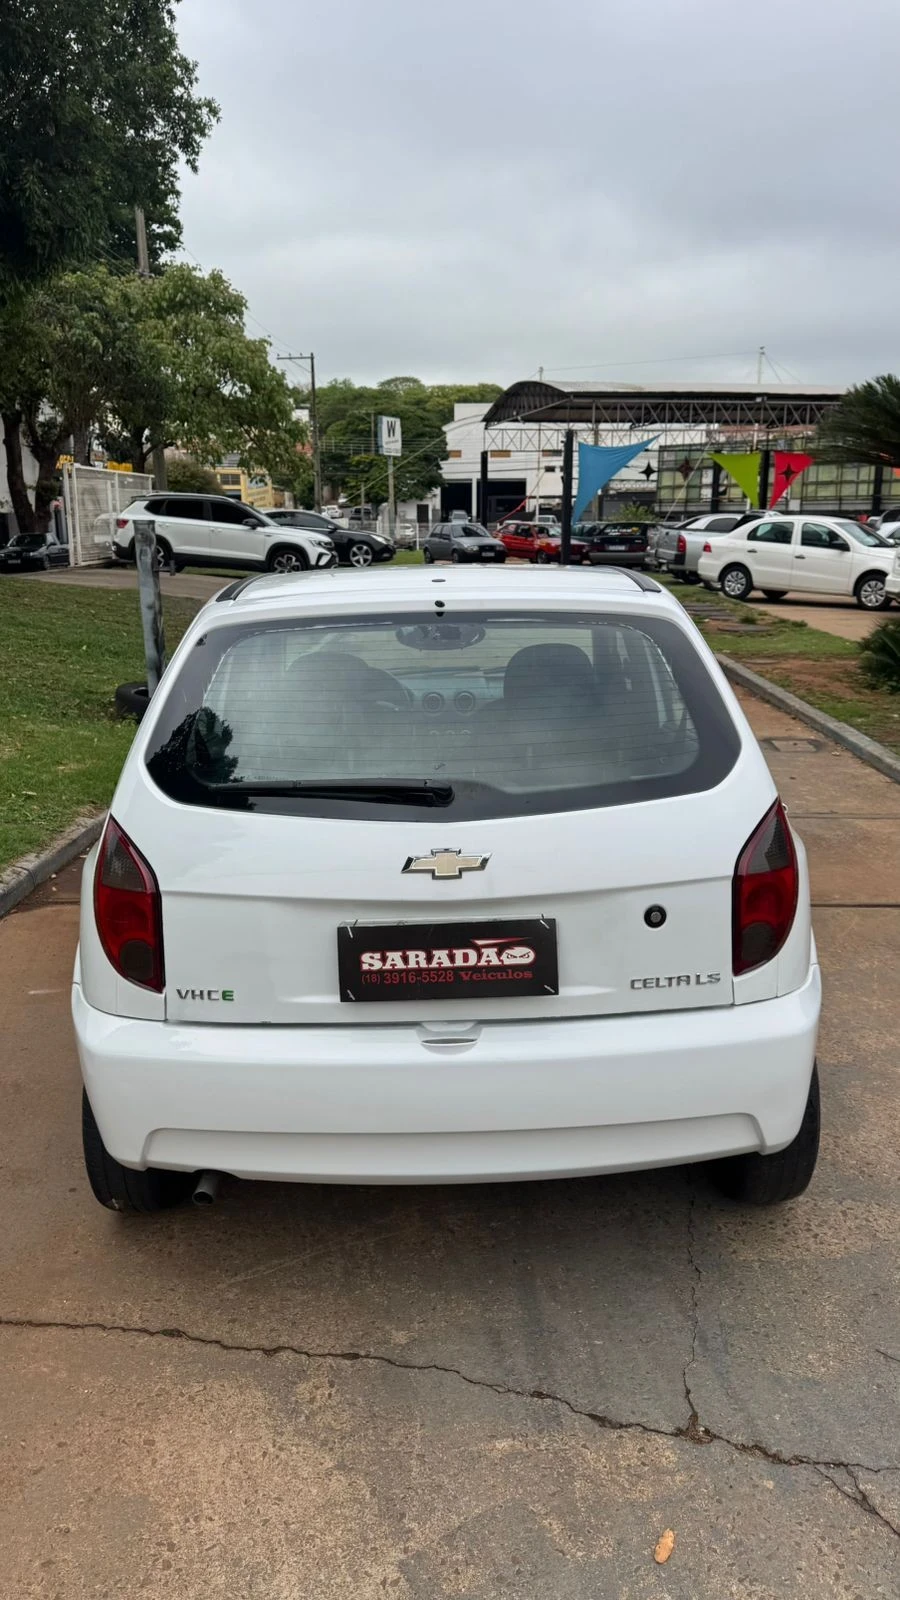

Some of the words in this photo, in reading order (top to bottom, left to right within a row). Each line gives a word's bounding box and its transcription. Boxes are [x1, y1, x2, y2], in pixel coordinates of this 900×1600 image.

[386, 420, 397, 438] W
[361, 974, 381, 985] (18)
[383, 970, 455, 984] 3916-5528
[630, 974, 691, 990] CELTA
[695, 973, 721, 986] LS
[176, 988, 235, 1002] VHCE
